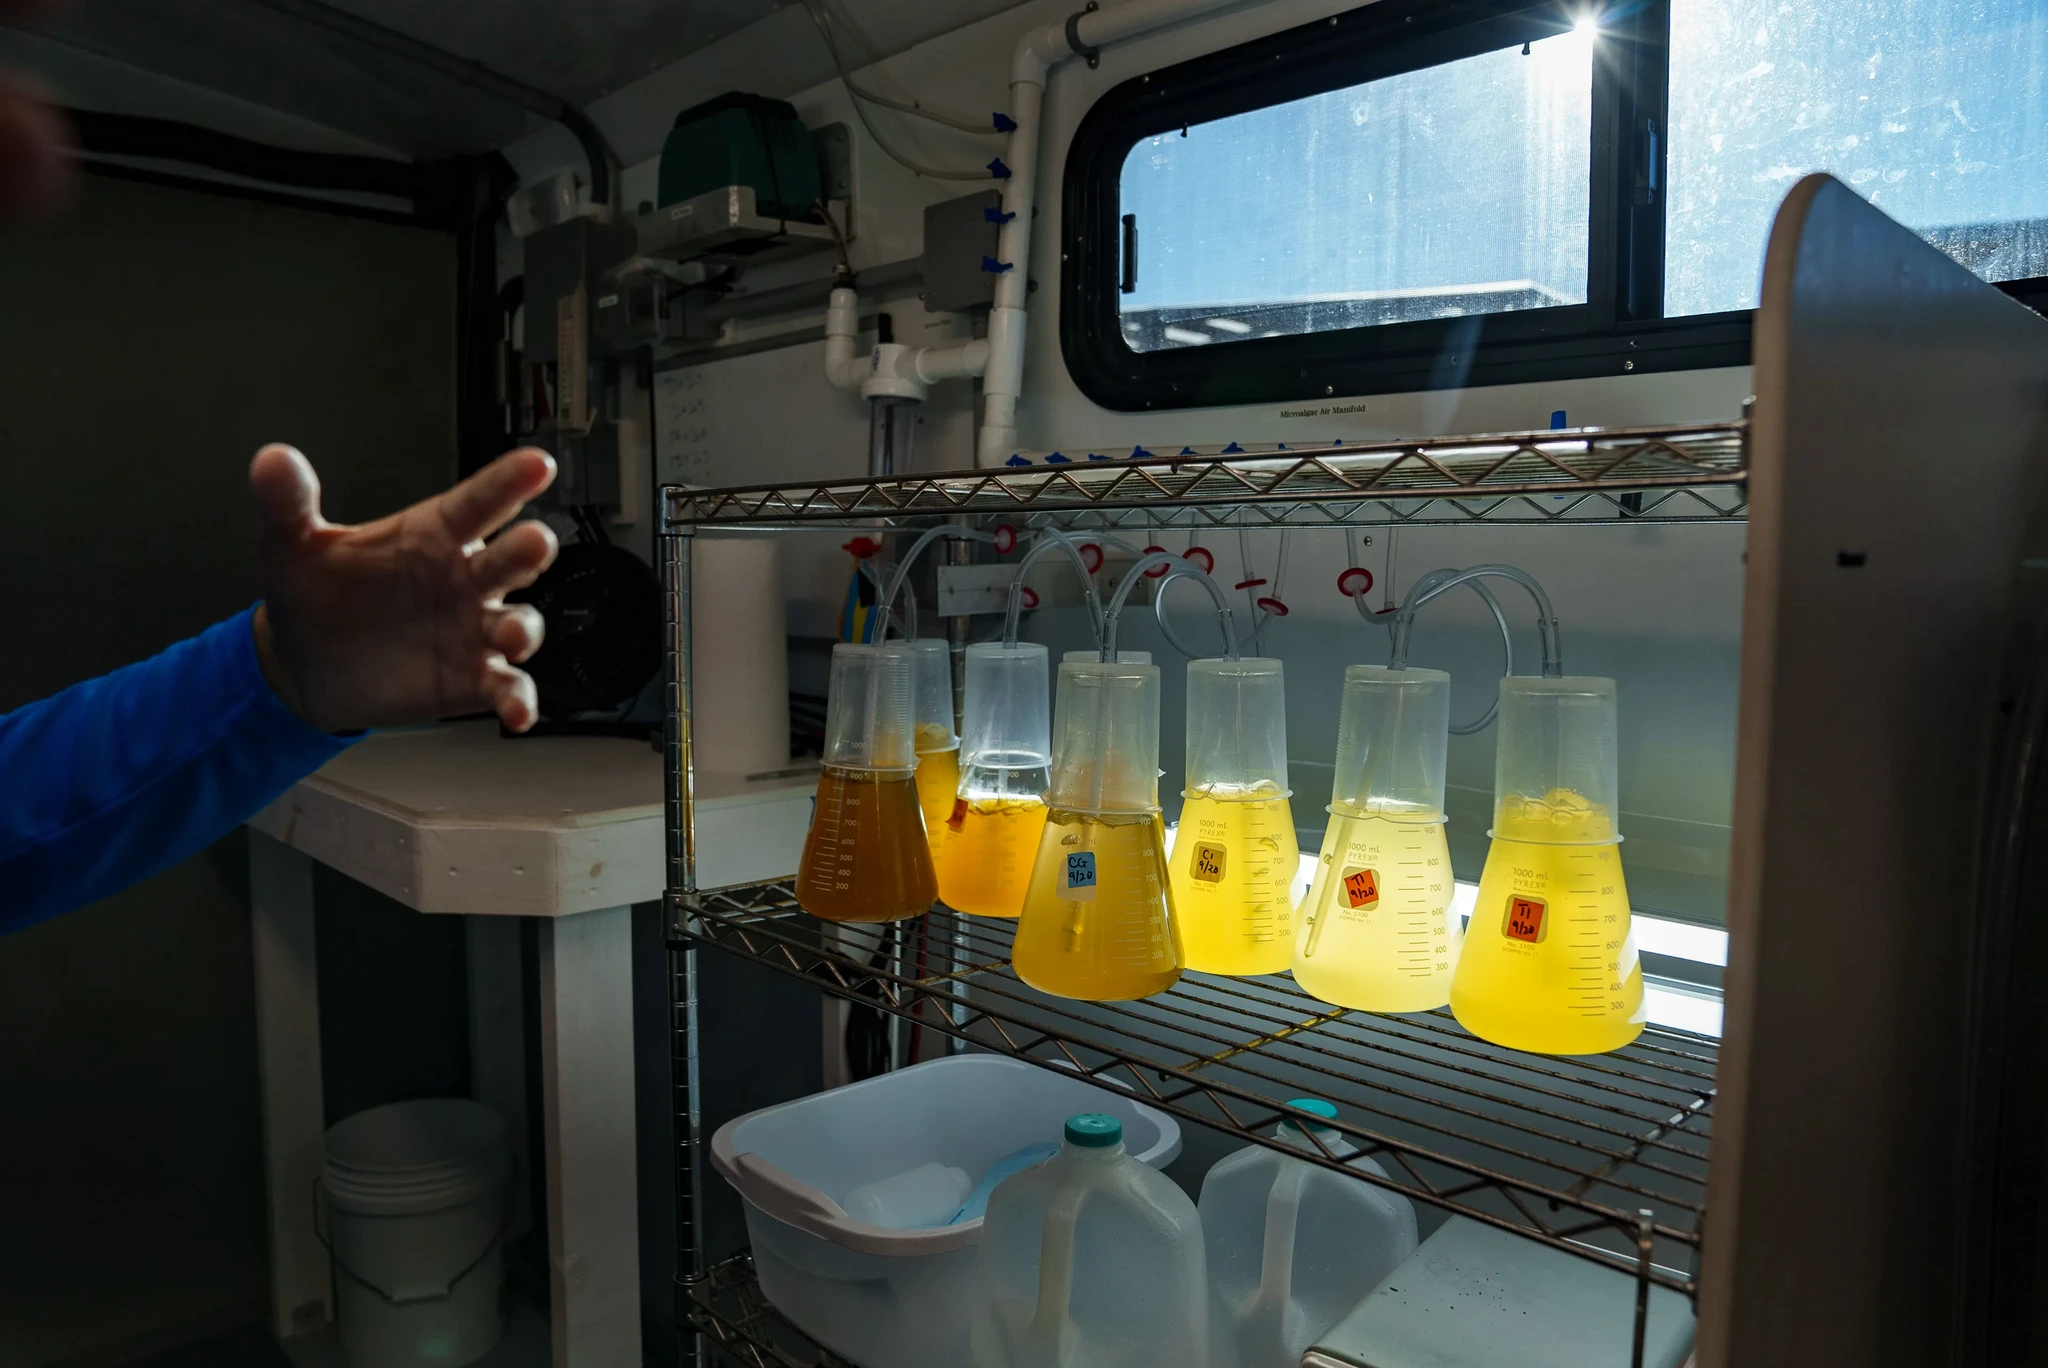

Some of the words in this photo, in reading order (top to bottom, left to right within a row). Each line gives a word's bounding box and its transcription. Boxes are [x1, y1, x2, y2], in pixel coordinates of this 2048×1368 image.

[1280, 409, 1318, 418] Microalgae
[1332, 404, 1365, 414] Manifold
[1200, 819, 1215, 827] 1000
[1348, 842, 1366, 851] 1000
[1598, 852, 1610, 860] 900
[1069, 857, 1087, 868] CG
[1427, 858, 1439, 866] 800
[1199, 860, 1218, 874] 9/20
[1069, 870, 1092, 883] 9/20
[1513, 868, 1533, 878] 1000
[1536, 872, 1549, 880] mL
[1429, 884, 1441, 892] 700
[1601, 886, 1614, 895] 800
[1350, 886, 1374, 900] 9/20
[1604, 914, 1617, 923] 700
[1512, 920, 1534, 935] 9/20
[1606, 940, 1619, 949] 600
[1152, 951, 1164, 959] 300
[1436, 962, 1448, 970] 300
[1608, 962, 1620, 971] 500
[1610, 982, 1622, 991] 400
[1611, 1001, 1624, 1010] 300
